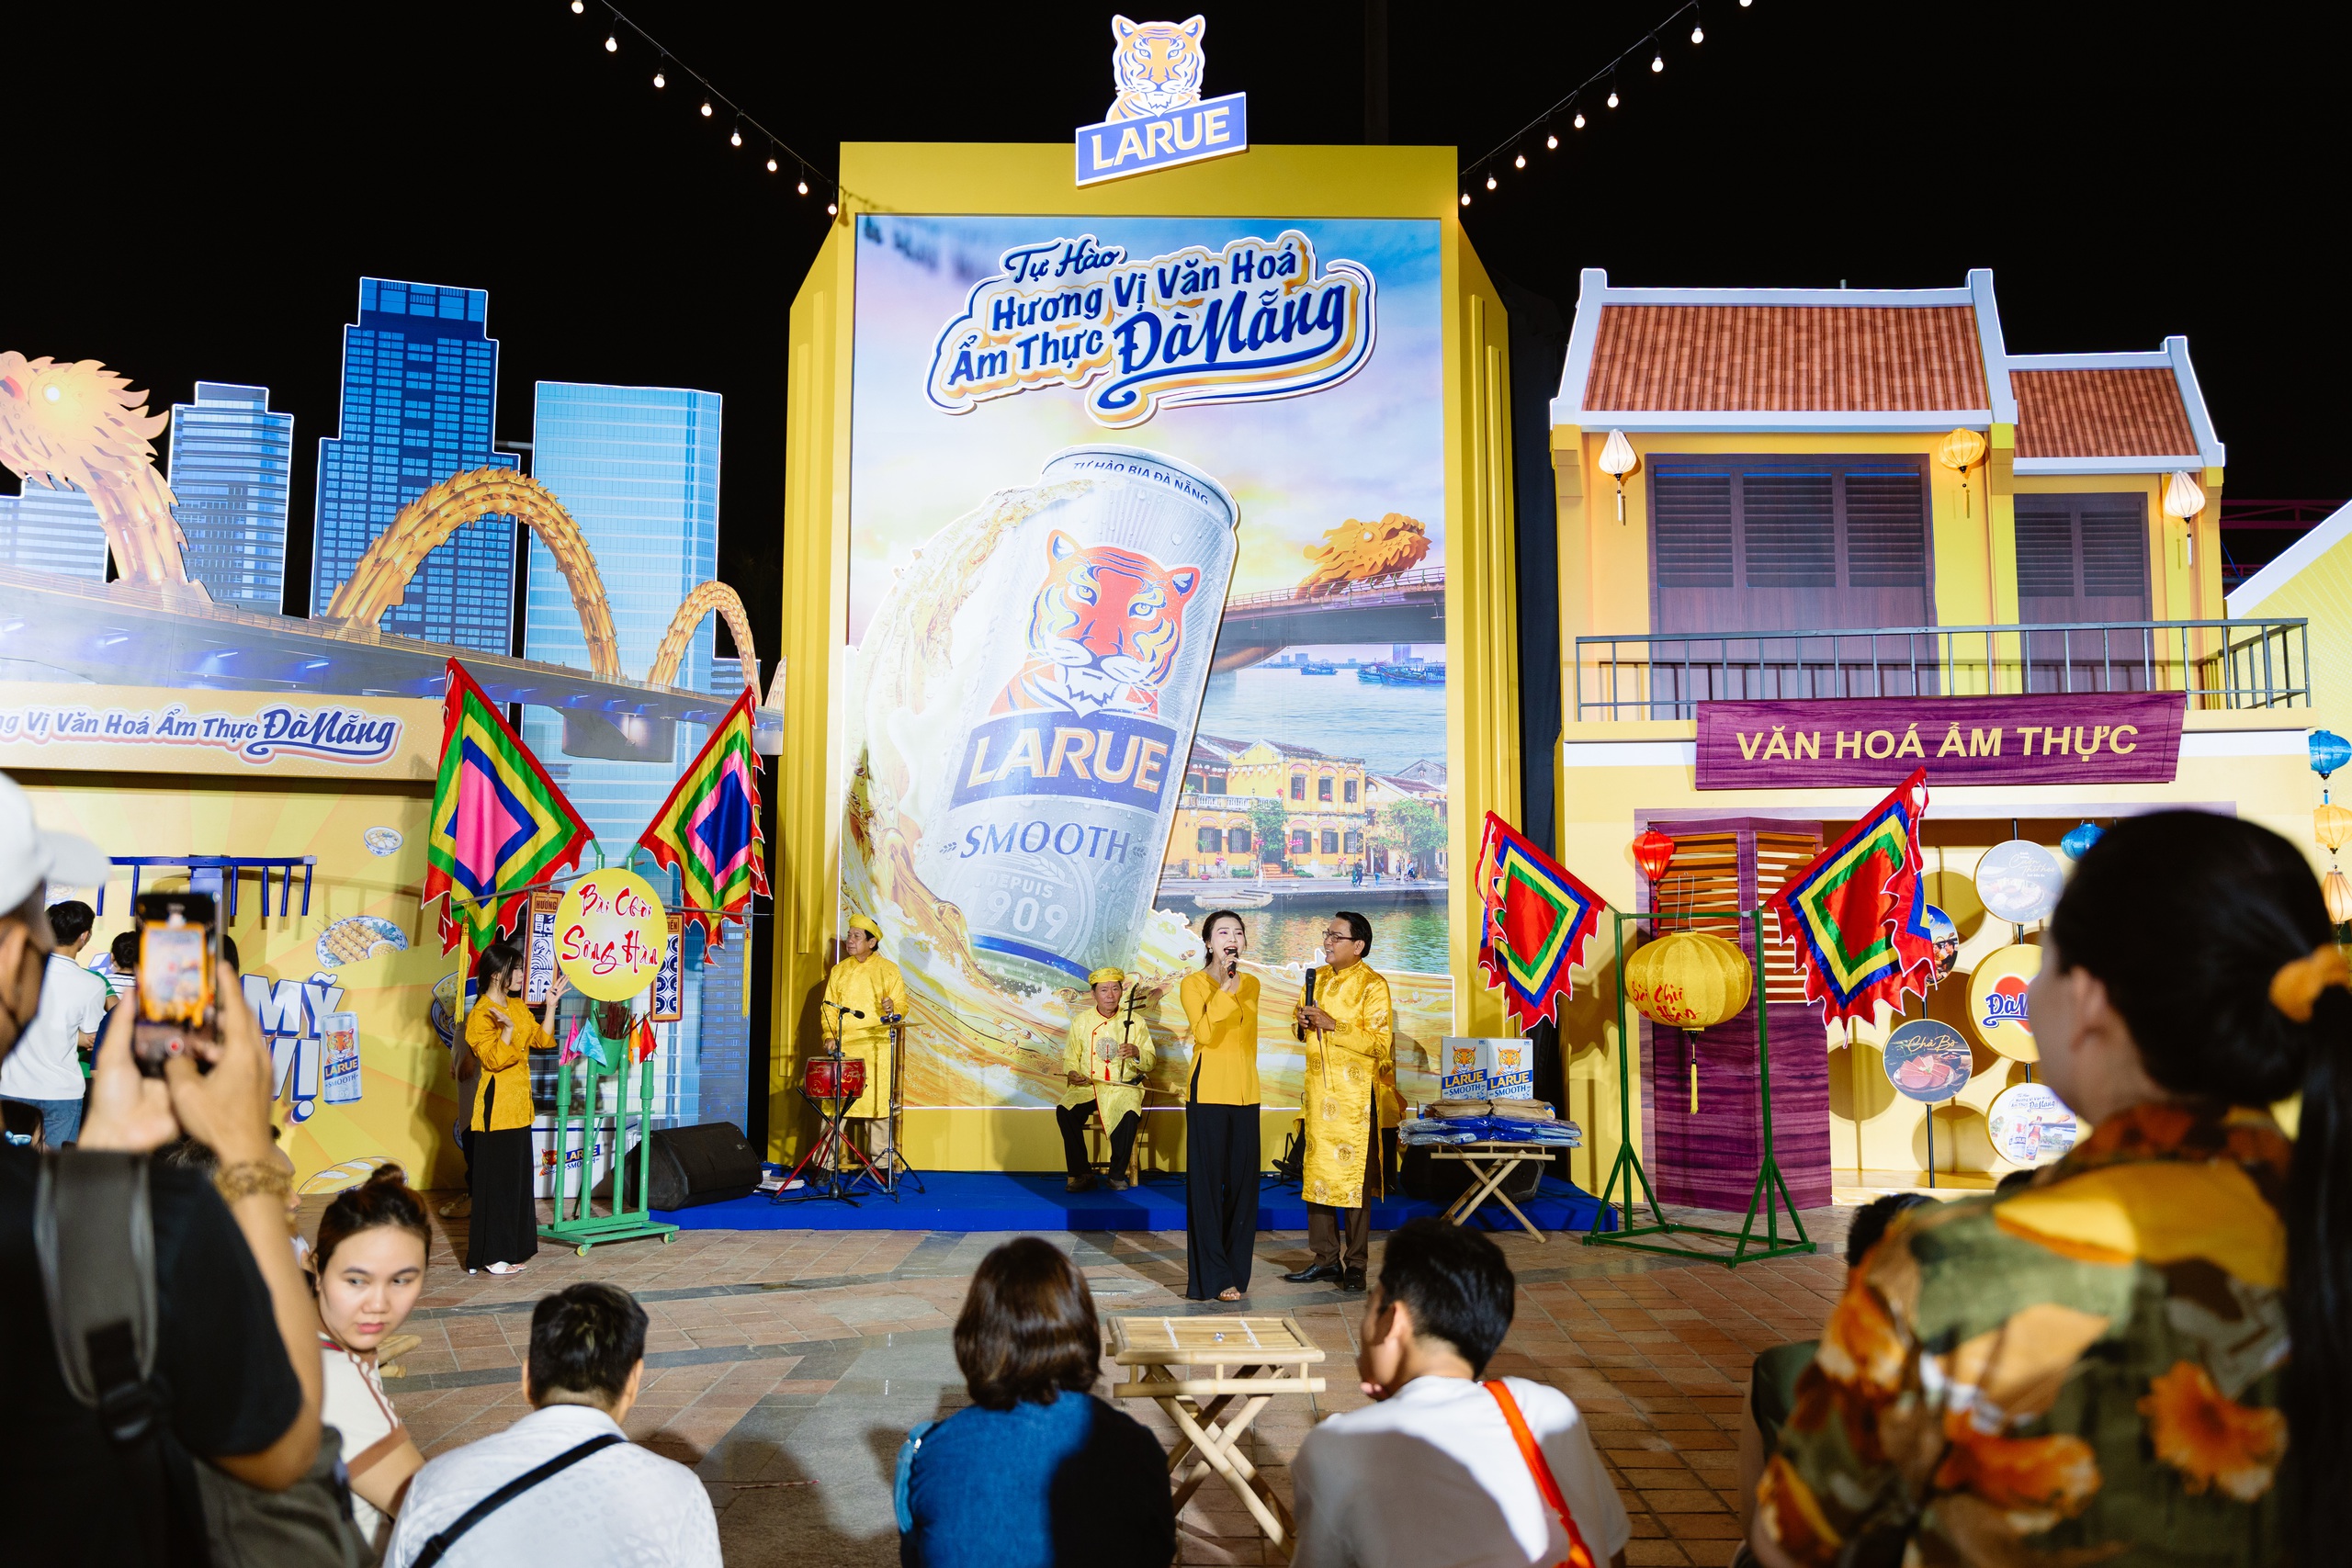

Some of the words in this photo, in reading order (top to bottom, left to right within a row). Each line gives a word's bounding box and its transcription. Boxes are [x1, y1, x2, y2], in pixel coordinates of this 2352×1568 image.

[1091, 107, 1230, 171] LARUE
[1004, 243, 1055, 283] Tự
[1054, 239, 1120, 278] Hào
[992, 288, 1102, 332] Hương
[1114, 272, 1148, 311] Vị
[1158, 256, 1221, 299] Văn
[1231, 243, 1296, 286] Hoá
[947, 333, 1009, 385] Ẩm
[1016, 331, 1103, 369] Thực
[1093, 459, 1125, 472] HÀO
[1127, 465, 1150, 479] BIA
[1153, 472, 1171, 486] ĐÀ
[1174, 479, 1209, 506] NẴNG
[28, 711, 51, 736] Vị
[57, 712, 99, 733] Văn
[105, 714, 150, 735] Hoá
[155, 708, 198, 737] Ẩm
[203, 717, 258, 743] Thực
[1736, 725, 1820, 761] VĂN
[1836, 722, 1926, 760] HOÁ
[1937, 721, 2003, 759] ẨM
[2017, 724, 2139, 762] THỰC
[967, 728, 1168, 794] LARUE
[960, 820, 1131, 864] SMOOTH
[578, 883, 609, 917] Bài
[984, 872, 1056, 899] DEPUIS
[621, 930, 659, 974] Hàn
[324, 1058, 358, 1077] LARUE
[328, 1073, 356, 1089] SMOOTH
[1445, 1070, 1484, 1089] LARUE
[1490, 1072, 1530, 1089] LARUE
[1449, 1084, 1481, 1096] SMOOTH
[1494, 1085, 1526, 1097] SMOOTH
[565, 1145, 598, 1162] LARE
